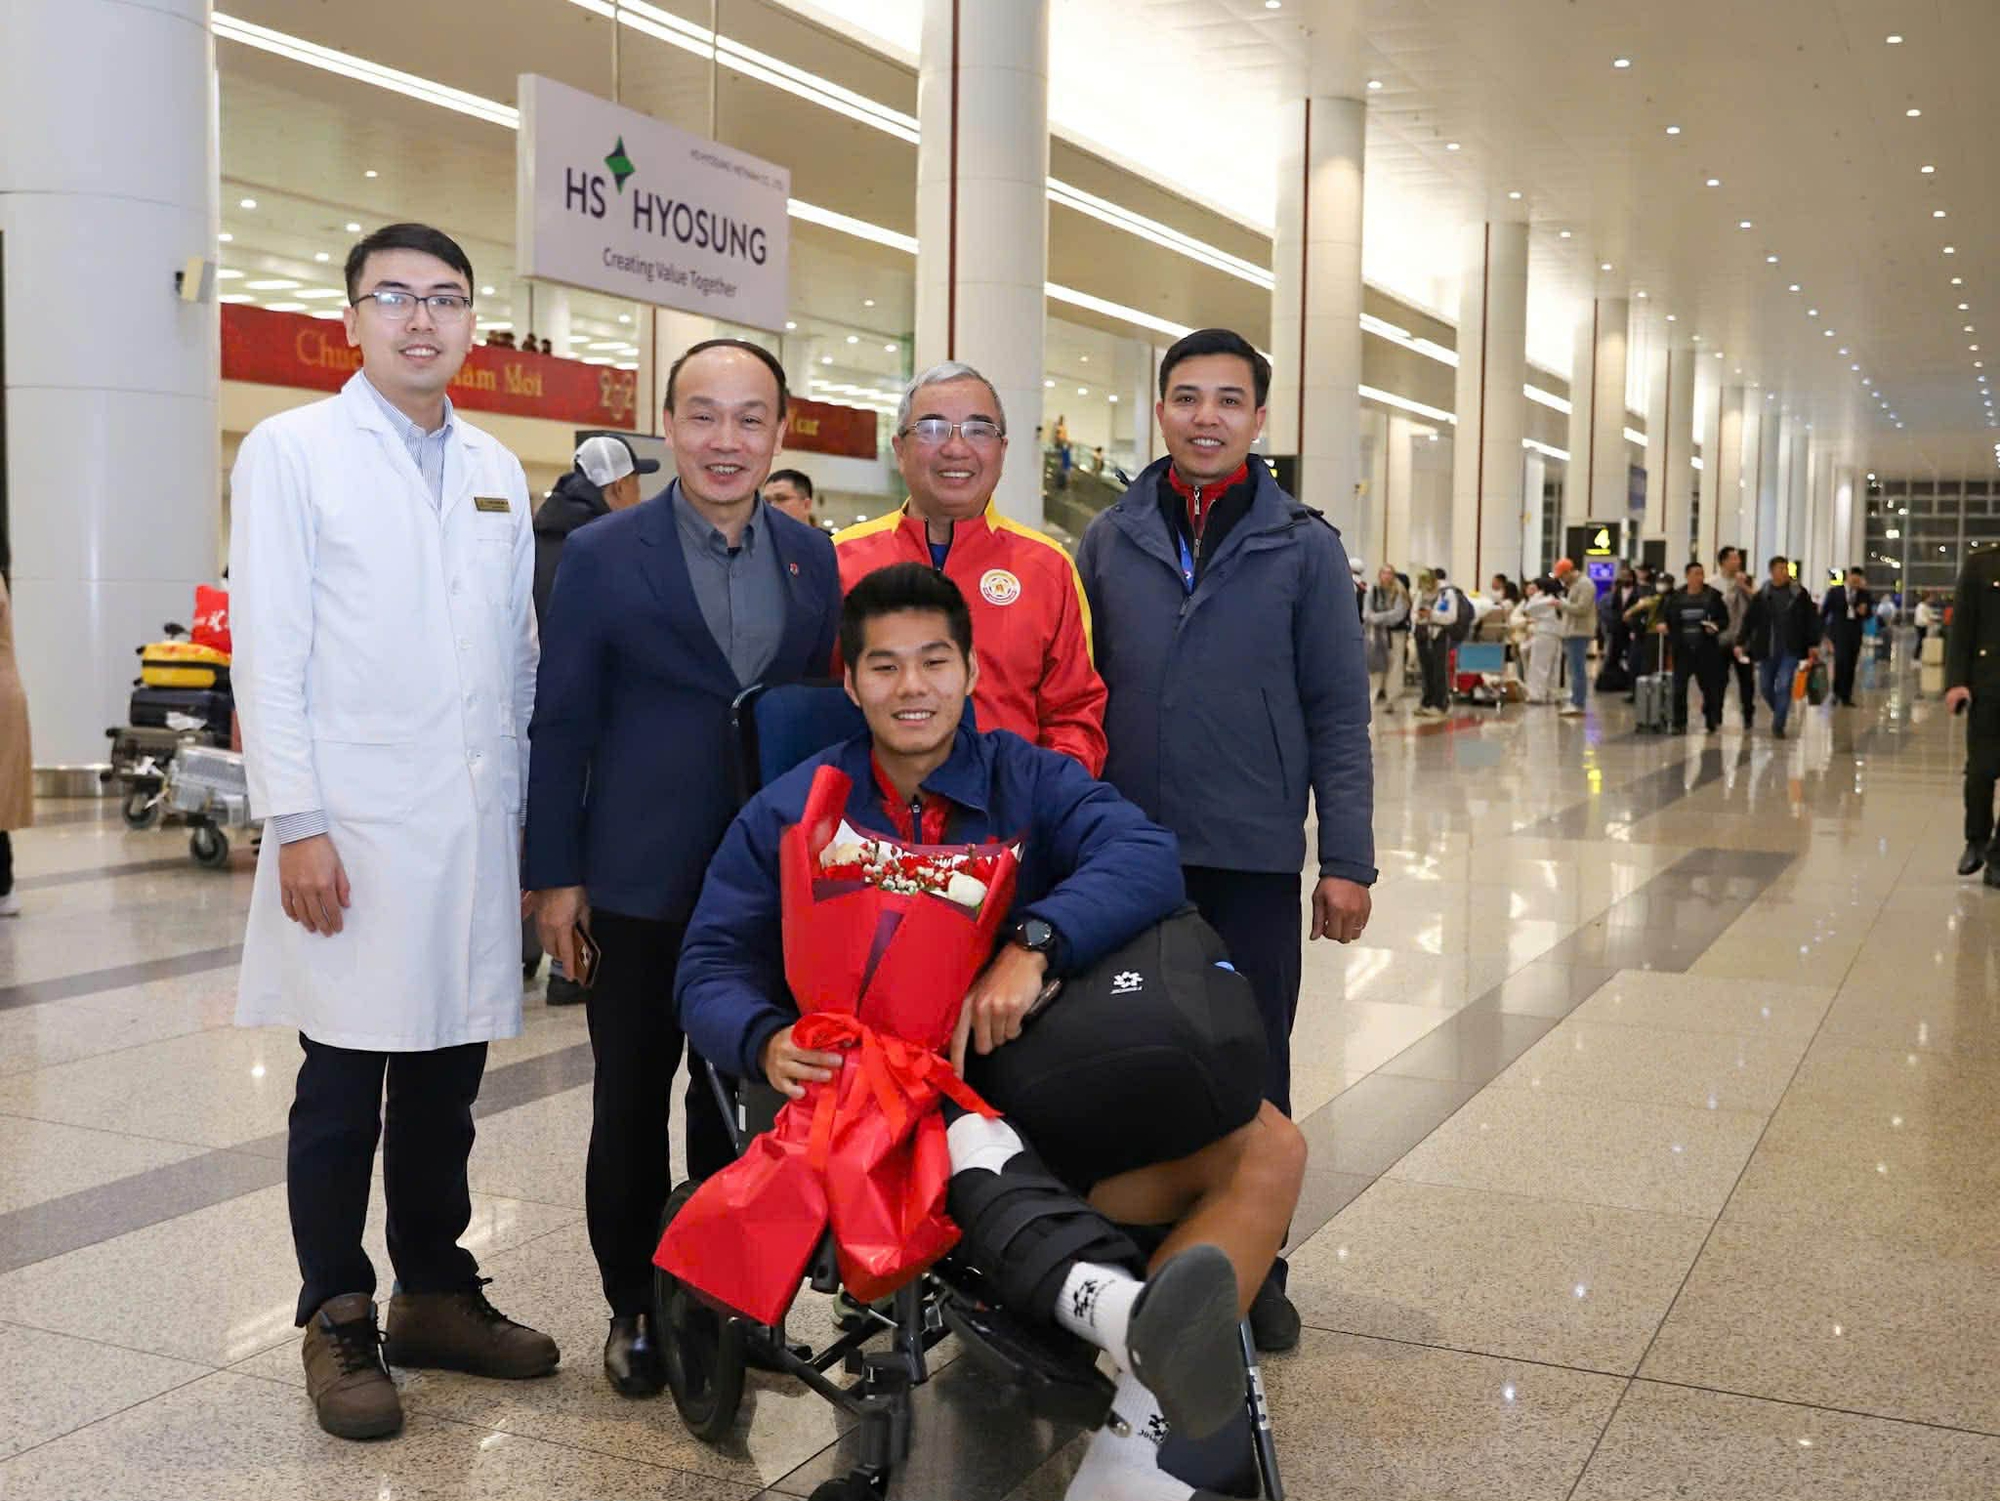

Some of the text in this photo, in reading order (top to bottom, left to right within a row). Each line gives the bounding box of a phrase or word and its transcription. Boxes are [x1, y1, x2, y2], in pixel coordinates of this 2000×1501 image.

[566, 167, 767, 265] HS HYOSUNG
[602, 247, 737, 298] Creating Value Together
[1594, 525, 1611, 549] 4
